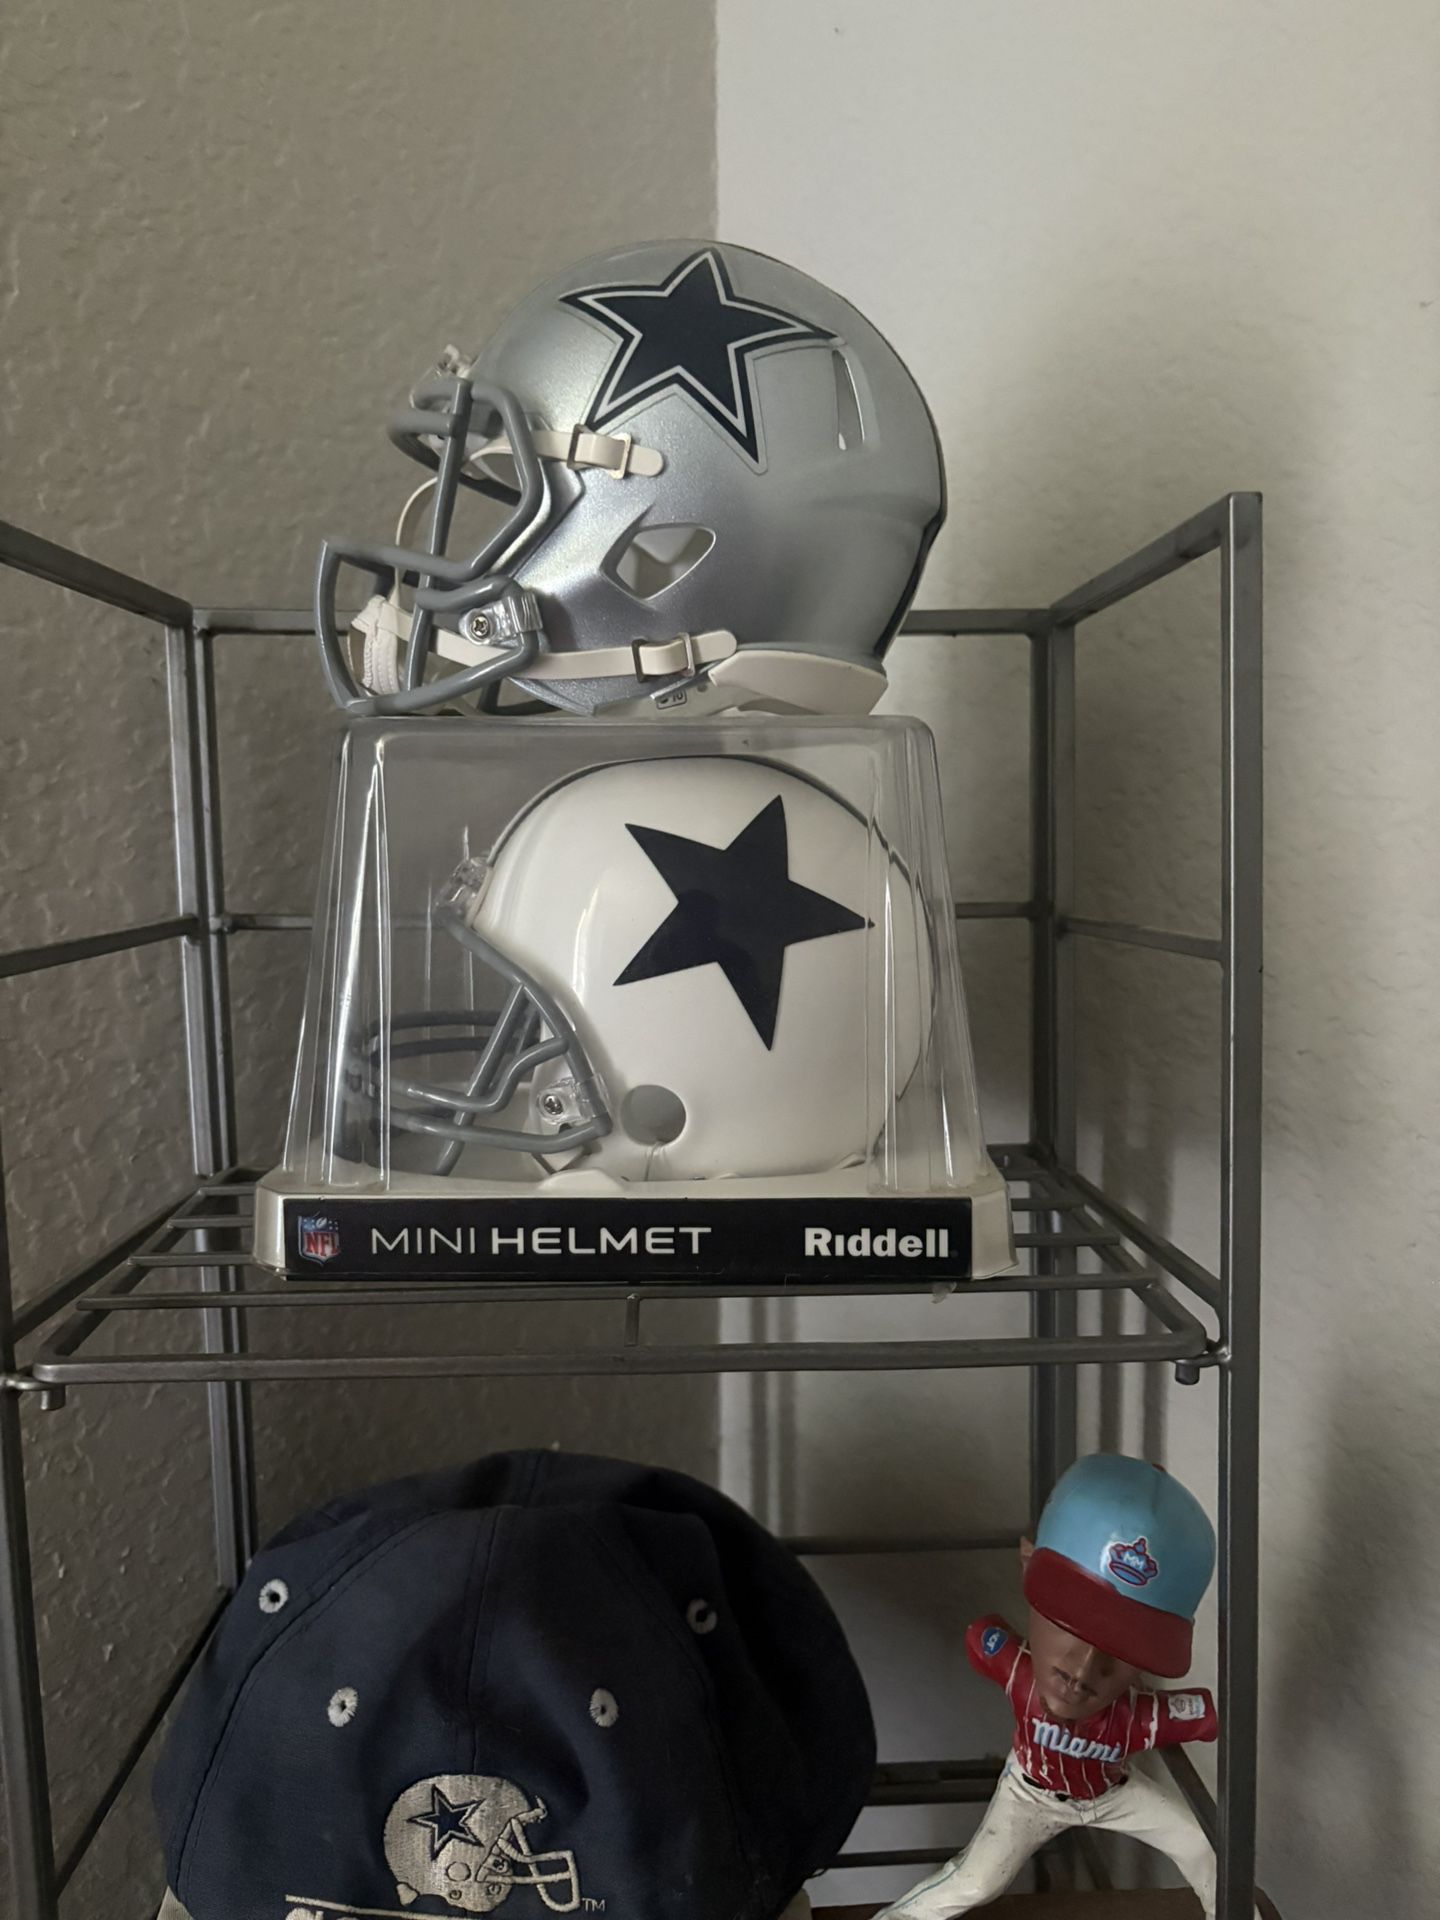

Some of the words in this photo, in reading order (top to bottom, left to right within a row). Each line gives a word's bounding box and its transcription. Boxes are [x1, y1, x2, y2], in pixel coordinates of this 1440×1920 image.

[303, 1231, 337, 1257] NFL
[371, 1227, 475, 1255] MINI
[491, 1227, 712, 1255] HELMET
[804, 1227, 949, 1257] Riddell
[1031, 1717, 1122, 1763] Miami
[581, 1896, 605, 1912] TM
